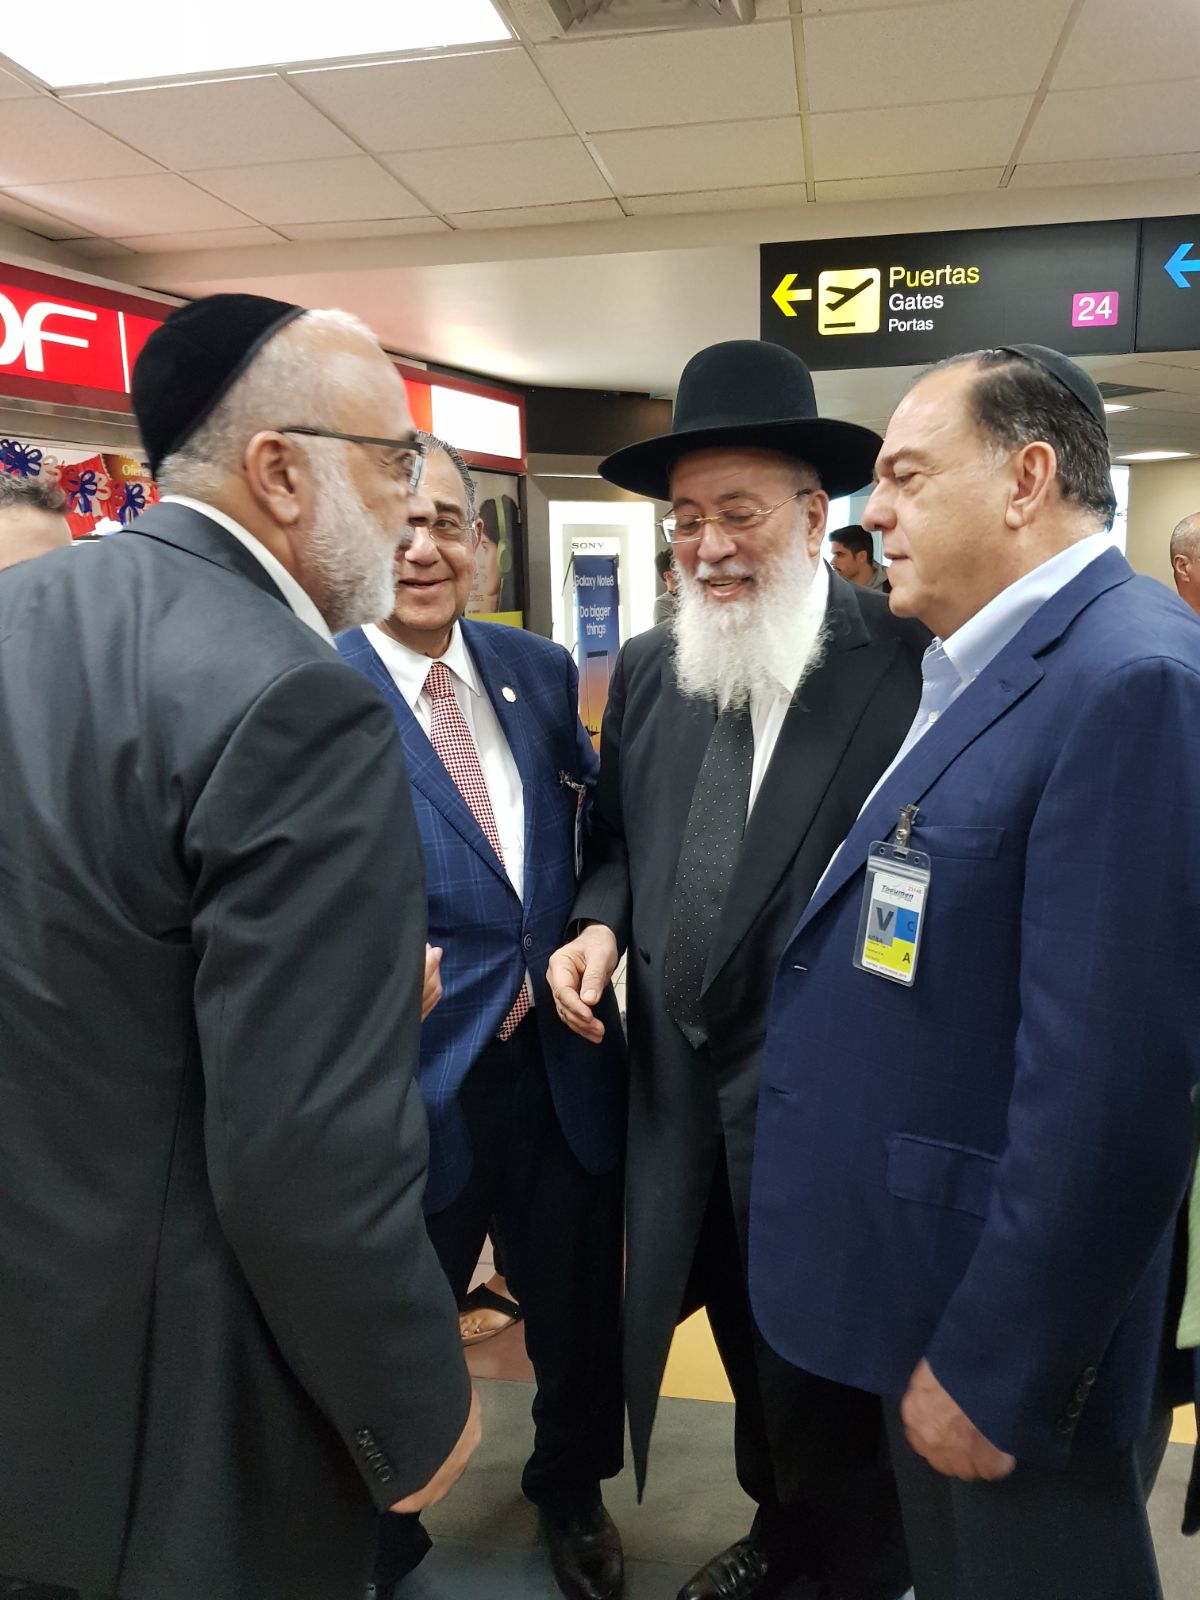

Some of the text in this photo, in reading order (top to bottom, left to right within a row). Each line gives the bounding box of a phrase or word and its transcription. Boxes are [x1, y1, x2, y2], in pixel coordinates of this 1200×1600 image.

[889, 265, 980, 288] Puertas
[889, 293, 944, 311] Gates
[1078, 295, 1112, 321] 24
[889, 318, 934, 332] Portas
[571, 542, 604, 550] SONY
[574, 575, 614, 590] Galaxy Note8
[580, 604, 611, 621] Do bigger
[586, 621, 607, 638] things
[876, 907, 894, 931] V
[908, 921, 914, 932] C
[902, 952, 911, 964] A
